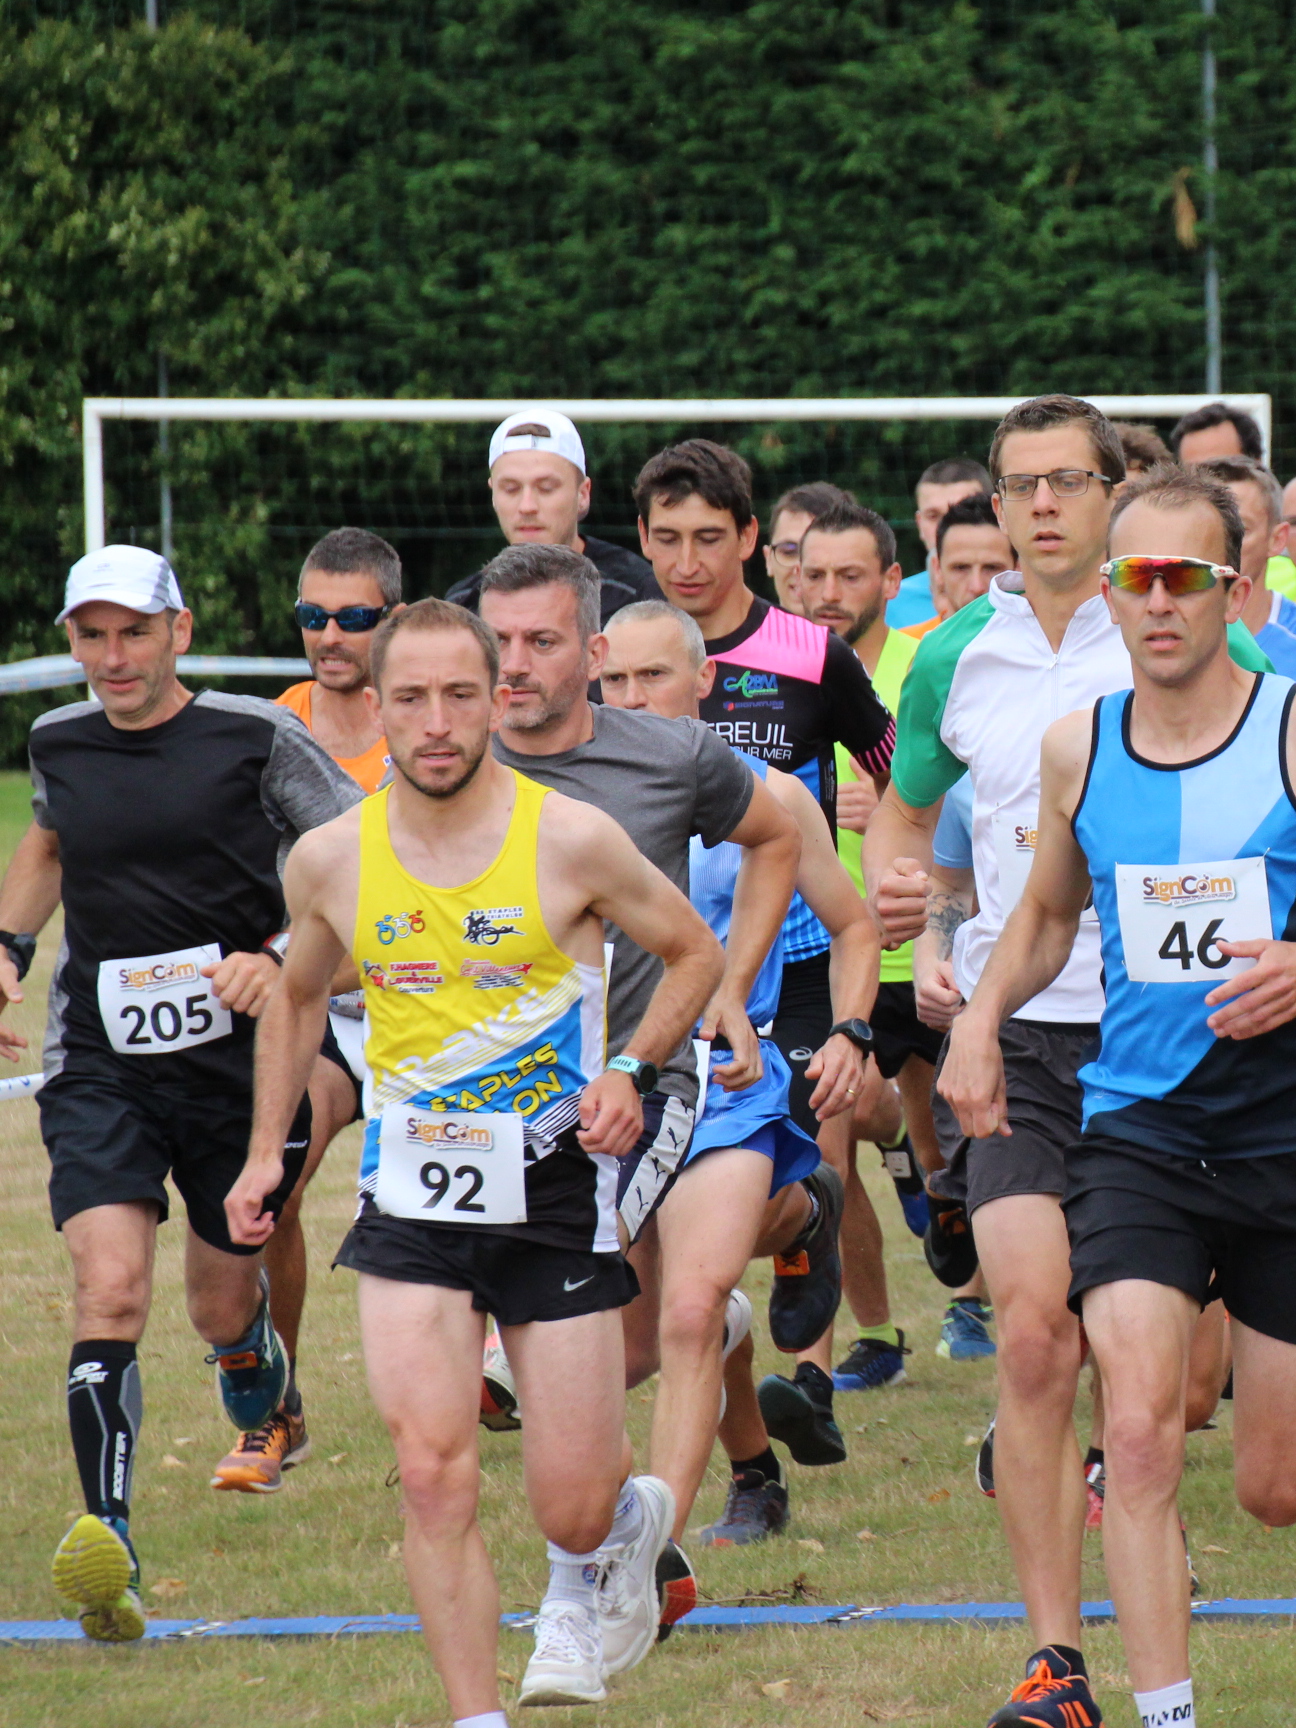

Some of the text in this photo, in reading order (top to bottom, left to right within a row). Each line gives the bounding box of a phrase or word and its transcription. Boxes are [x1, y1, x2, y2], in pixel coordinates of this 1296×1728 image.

[762, 748, 792, 760] MER
[1158, 918, 1233, 970] 46
[120, 994, 212, 1045] 205
[420, 1161, 486, 1213] 92
[112, 1431, 127, 1500] BOOSTER
